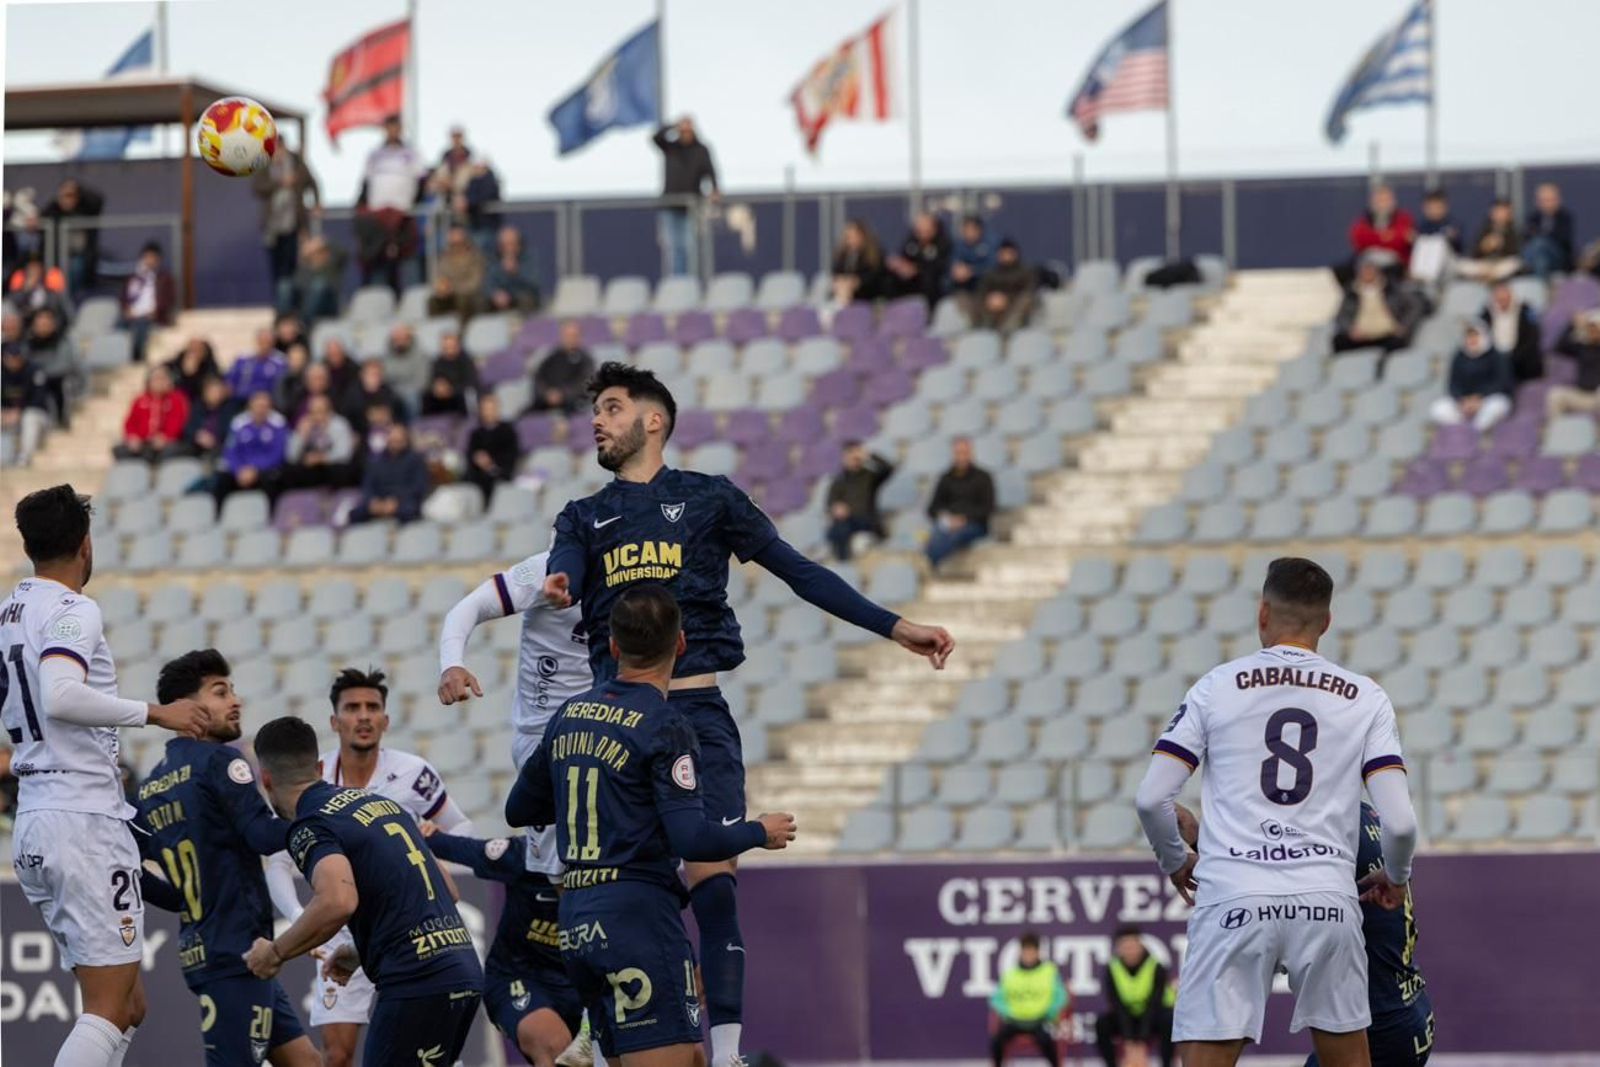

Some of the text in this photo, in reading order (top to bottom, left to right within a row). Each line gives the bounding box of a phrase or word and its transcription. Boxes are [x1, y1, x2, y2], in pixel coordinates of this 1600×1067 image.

[604, 541, 682, 574] UCAM
[1236, 667, 1359, 700] CABALLERO
[562, 702, 621, 724] HEREDIA
[1260, 708, 1318, 806] 8
[566, 766, 602, 861] 11
[383, 822, 436, 901] 7
[938, 876, 1192, 925] CERVEZ
[250, 1005, 273, 1040] 20
